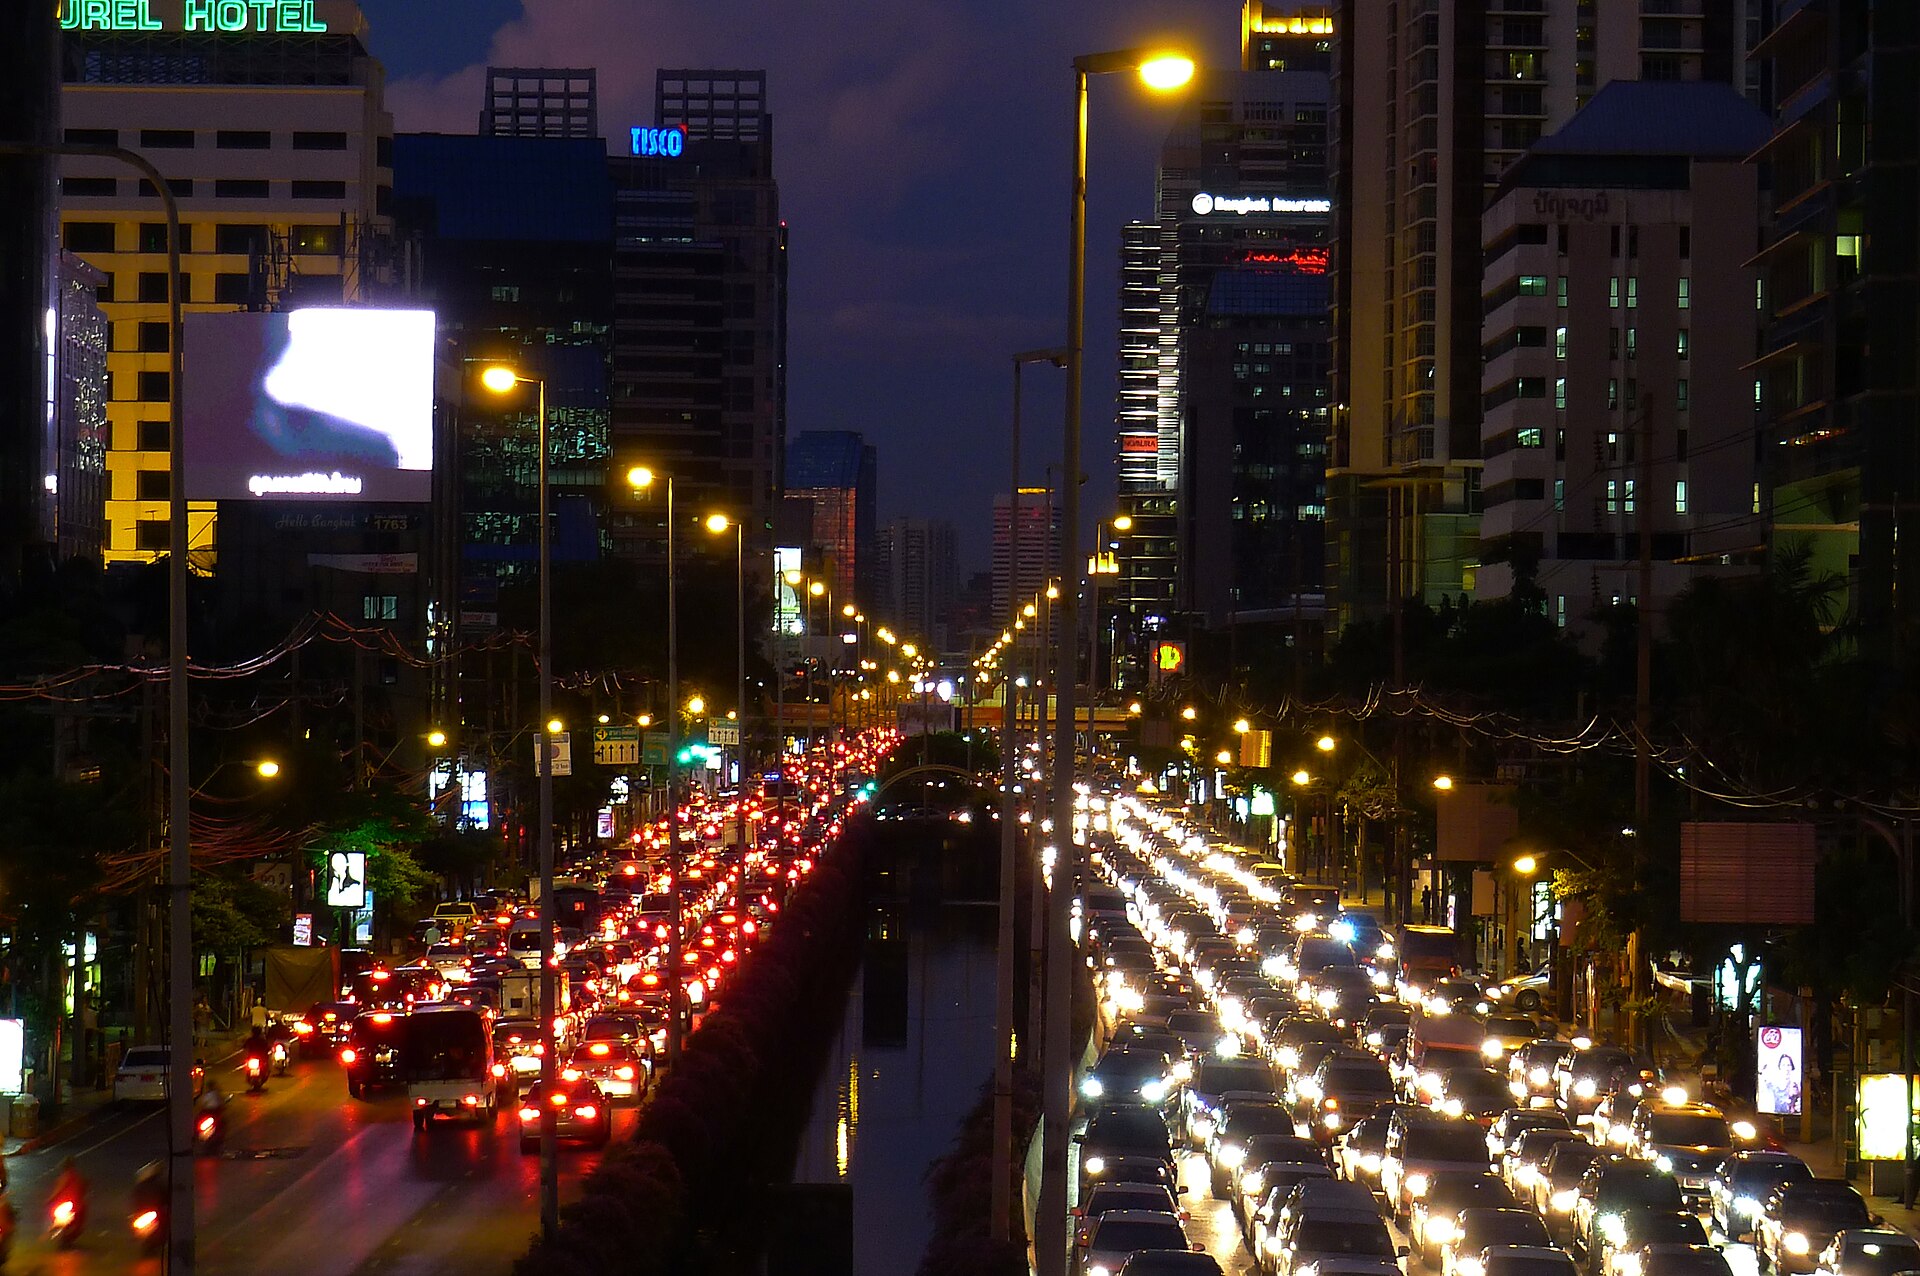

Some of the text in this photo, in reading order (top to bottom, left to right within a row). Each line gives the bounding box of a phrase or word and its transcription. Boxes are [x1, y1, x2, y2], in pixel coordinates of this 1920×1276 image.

[184, 0, 328, 33] HOTEL
[630, 127, 683, 157] TISCO
[1214, 196, 1270, 215] Bangkok
[275, 513, 356, 531] Hello Bangkok
[374, 519, 408, 530] 1763
